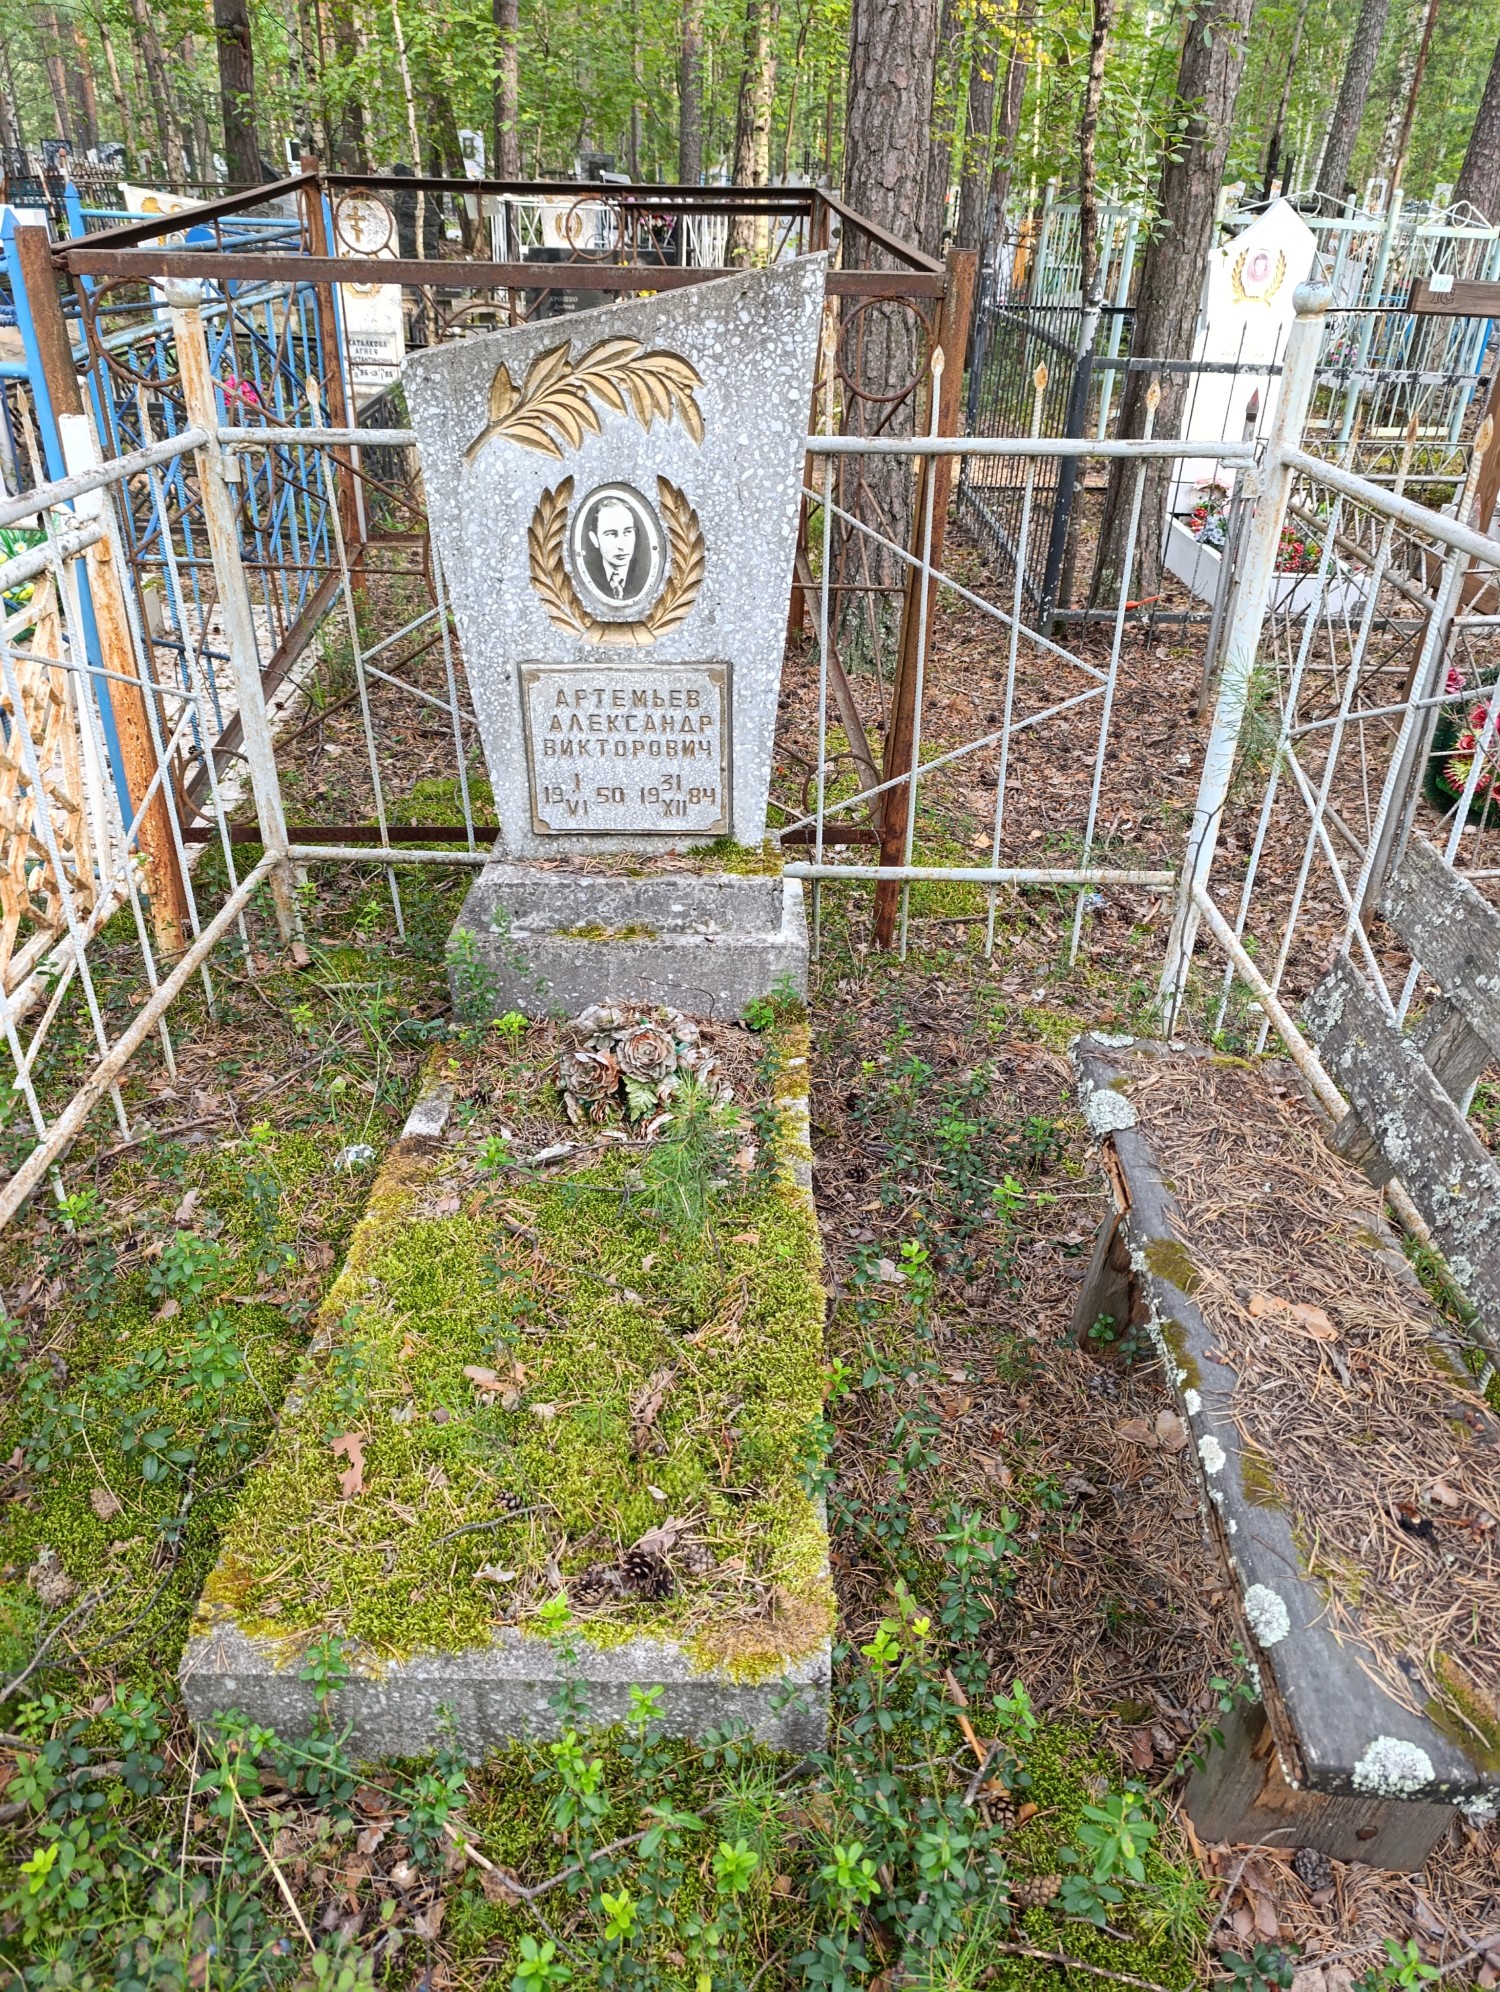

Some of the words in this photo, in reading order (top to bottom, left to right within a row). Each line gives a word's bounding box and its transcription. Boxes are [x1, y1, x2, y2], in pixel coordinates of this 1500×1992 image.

[555, 688, 701, 708] АРТЕМЬЕВ
[549, 713, 713, 734] АЛЕКСАНДР
[543, 738, 712, 760] ВИКТОРОВИЧ
[660, 774, 682, 792] 31
[543, 786, 564, 804] 19
[596, 787, 625, 805] 50
[640, 786, 660, 804] 19
[687, 787, 716, 806] 84
[566, 799, 588, 818] VI
[661, 799, 688, 818] XII
